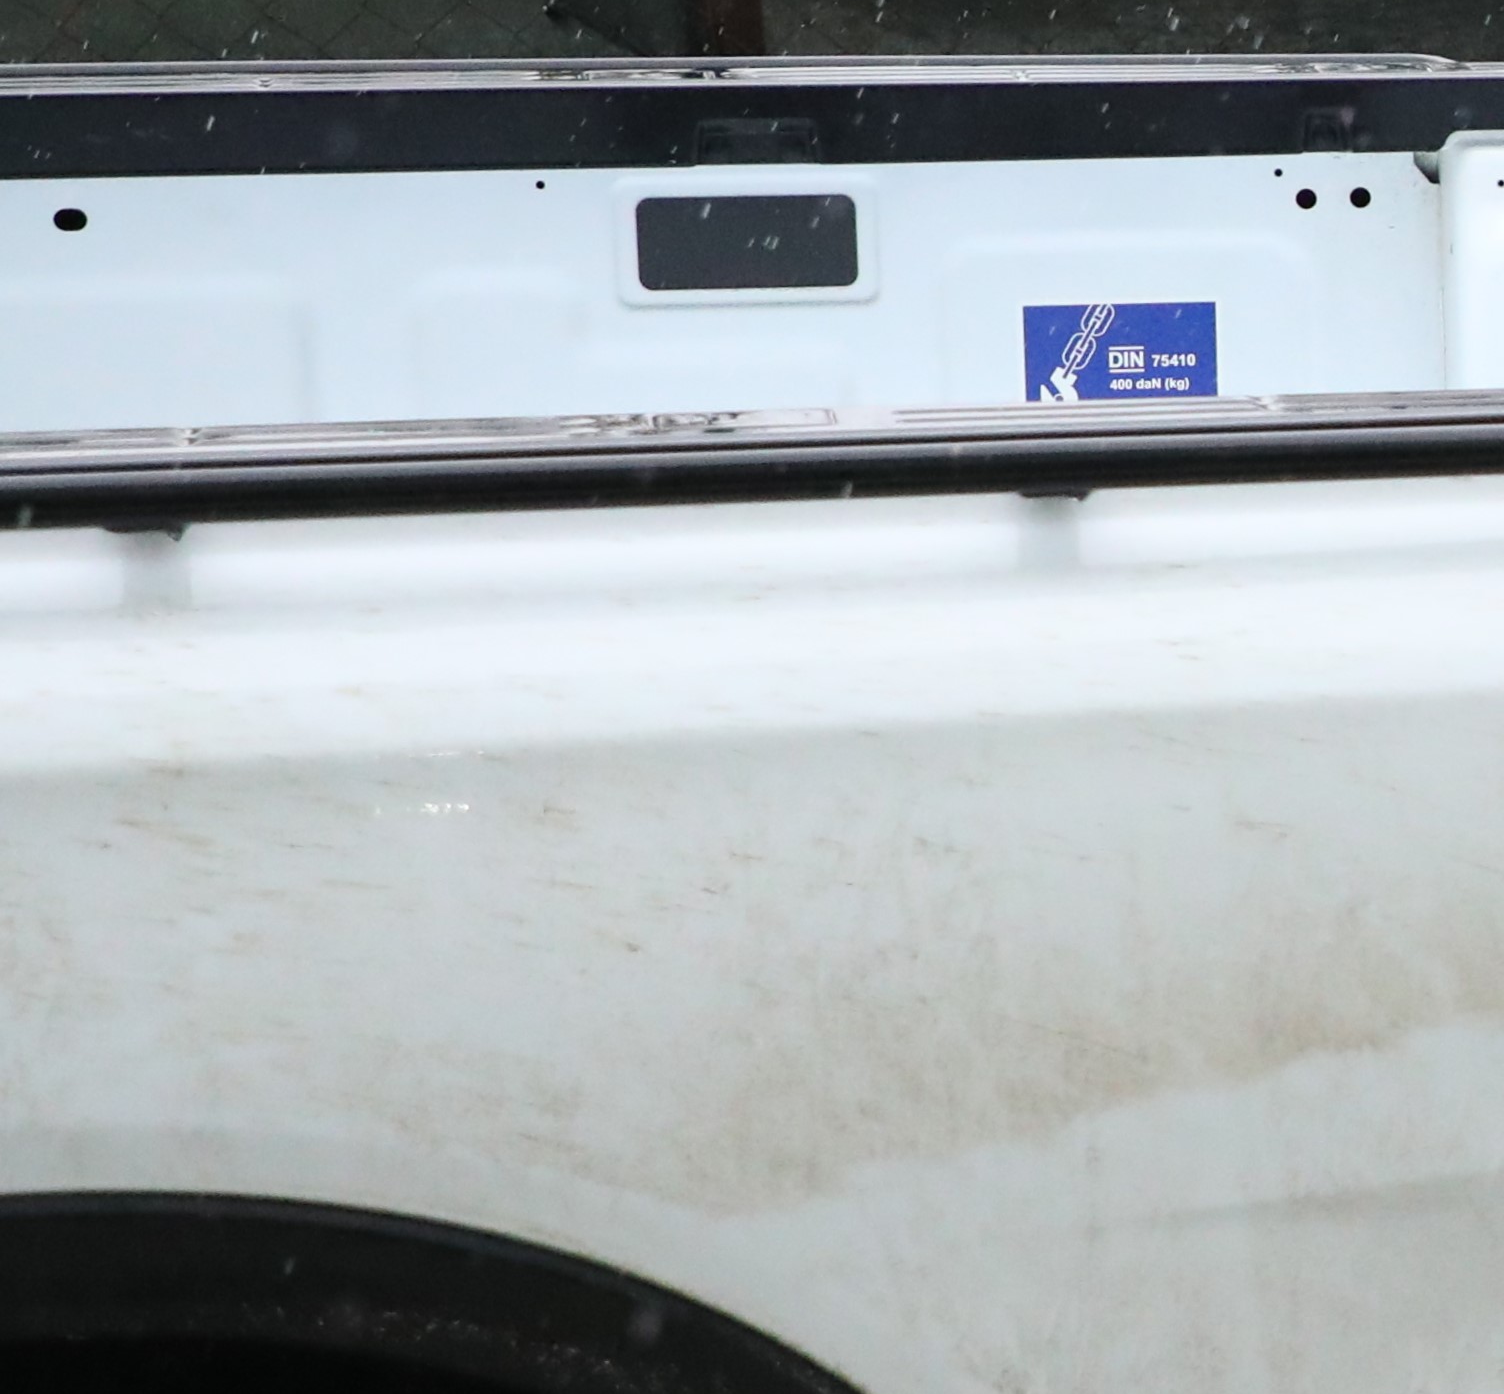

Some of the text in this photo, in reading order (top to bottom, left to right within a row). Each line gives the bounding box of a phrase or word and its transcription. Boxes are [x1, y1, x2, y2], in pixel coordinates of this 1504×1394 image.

[1108, 351, 1196, 368] DIN 75410
[1109, 377, 1190, 391] 400 daN (kg)
